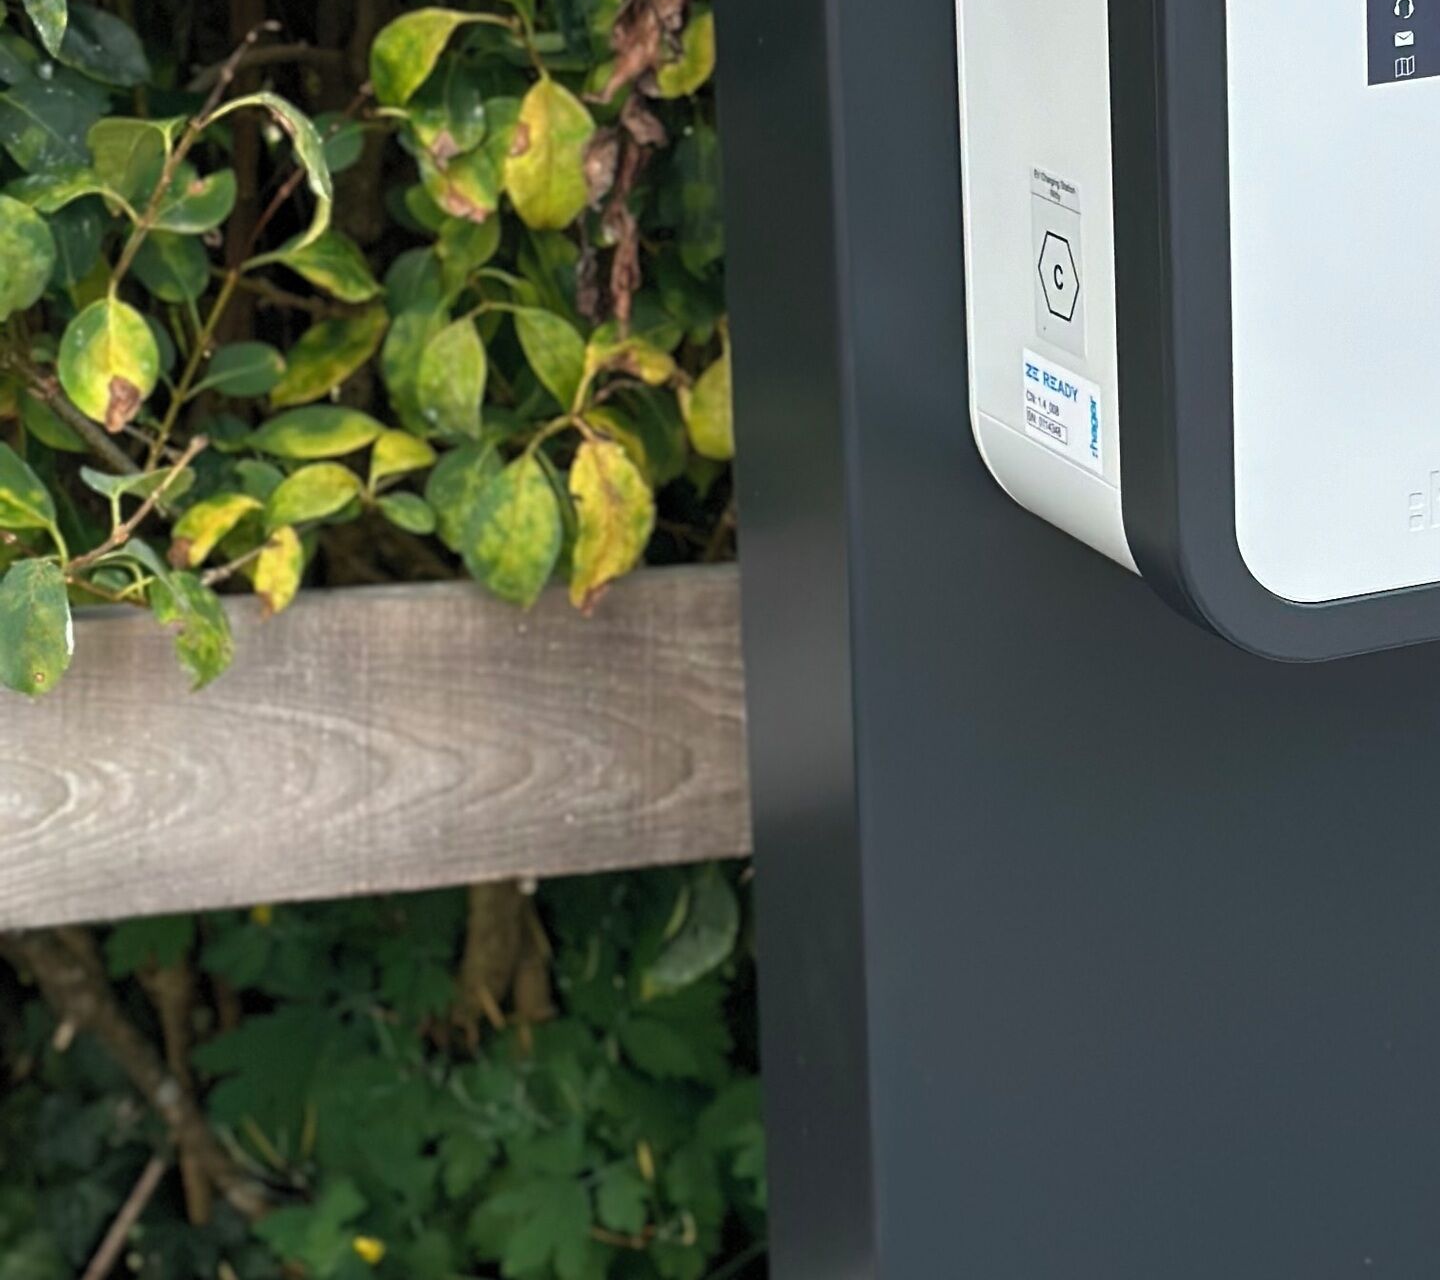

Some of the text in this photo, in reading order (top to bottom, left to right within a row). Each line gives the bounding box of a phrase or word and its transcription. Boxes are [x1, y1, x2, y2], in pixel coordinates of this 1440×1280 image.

[1053, 264, 1064, 291] C
[1025, 362, 1078, 402] ZE READY
